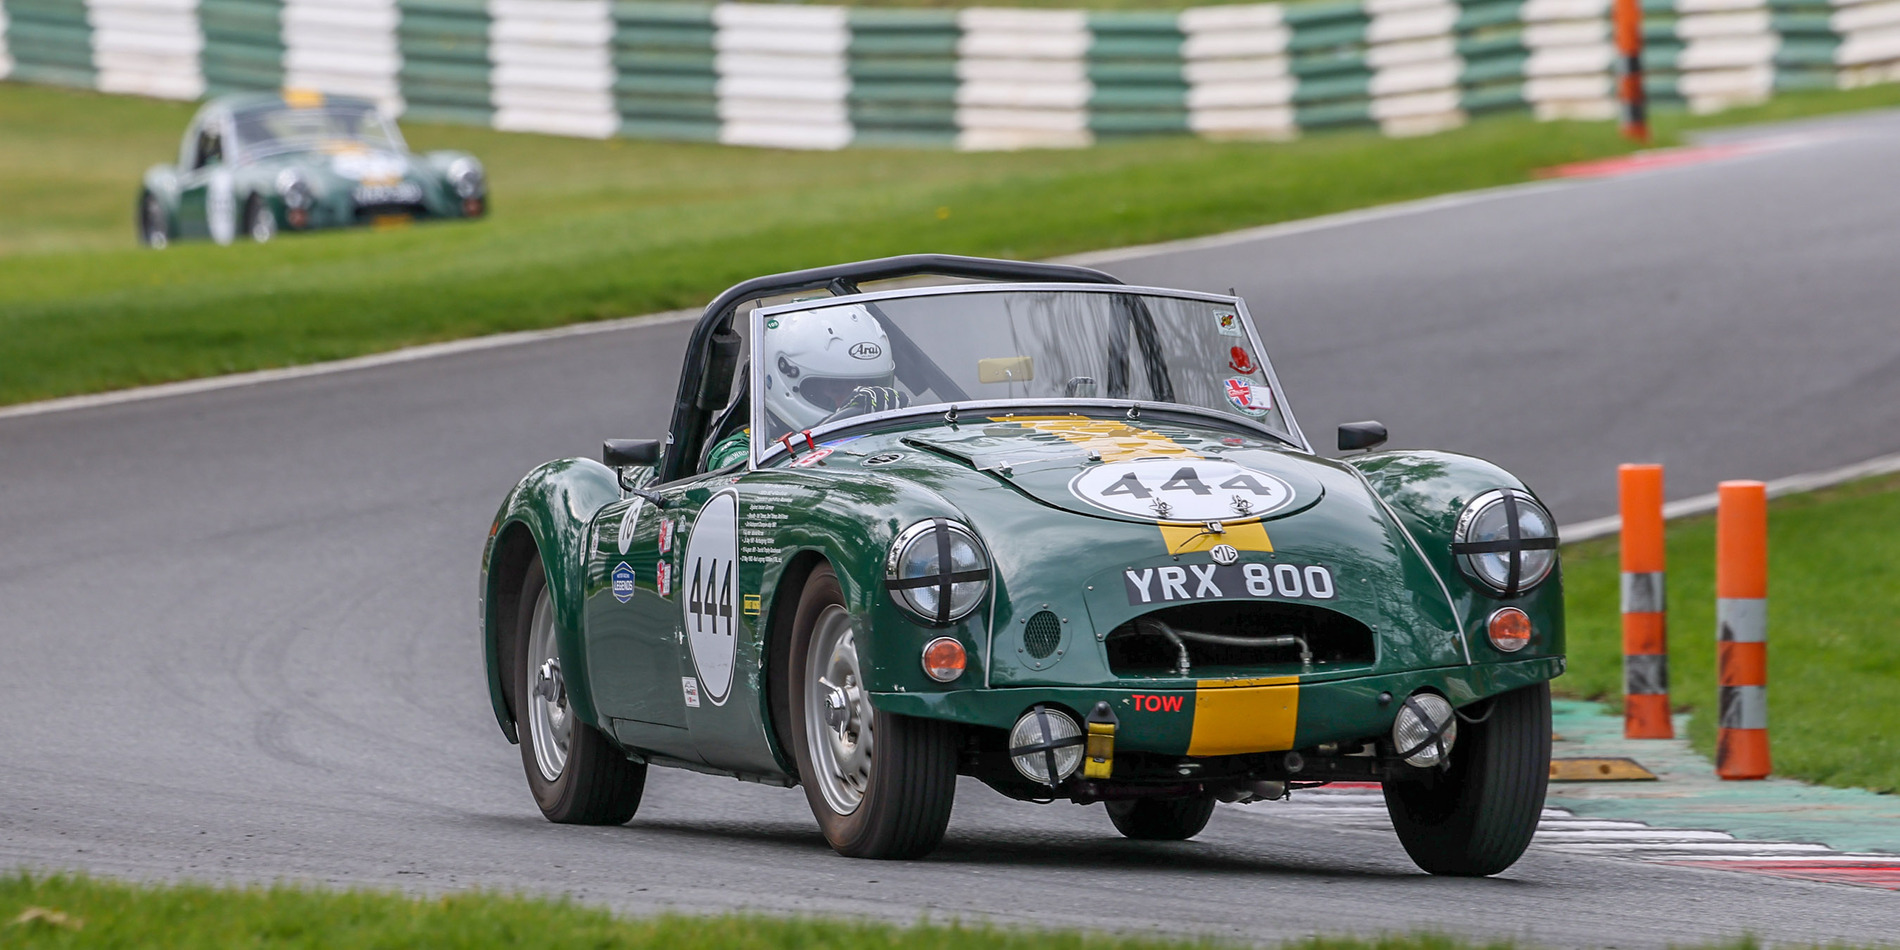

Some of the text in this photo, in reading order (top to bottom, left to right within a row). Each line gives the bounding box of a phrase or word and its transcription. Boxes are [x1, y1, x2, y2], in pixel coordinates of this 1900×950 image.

[852, 344, 878, 356] Arai
[1101, 467, 1271, 499] 444
[1213, 546, 1237, 562] MG
[1126, 563, 1335, 603] YRX 800
[689, 557, 732, 636] 444
[1132, 694, 1184, 712] TOW
